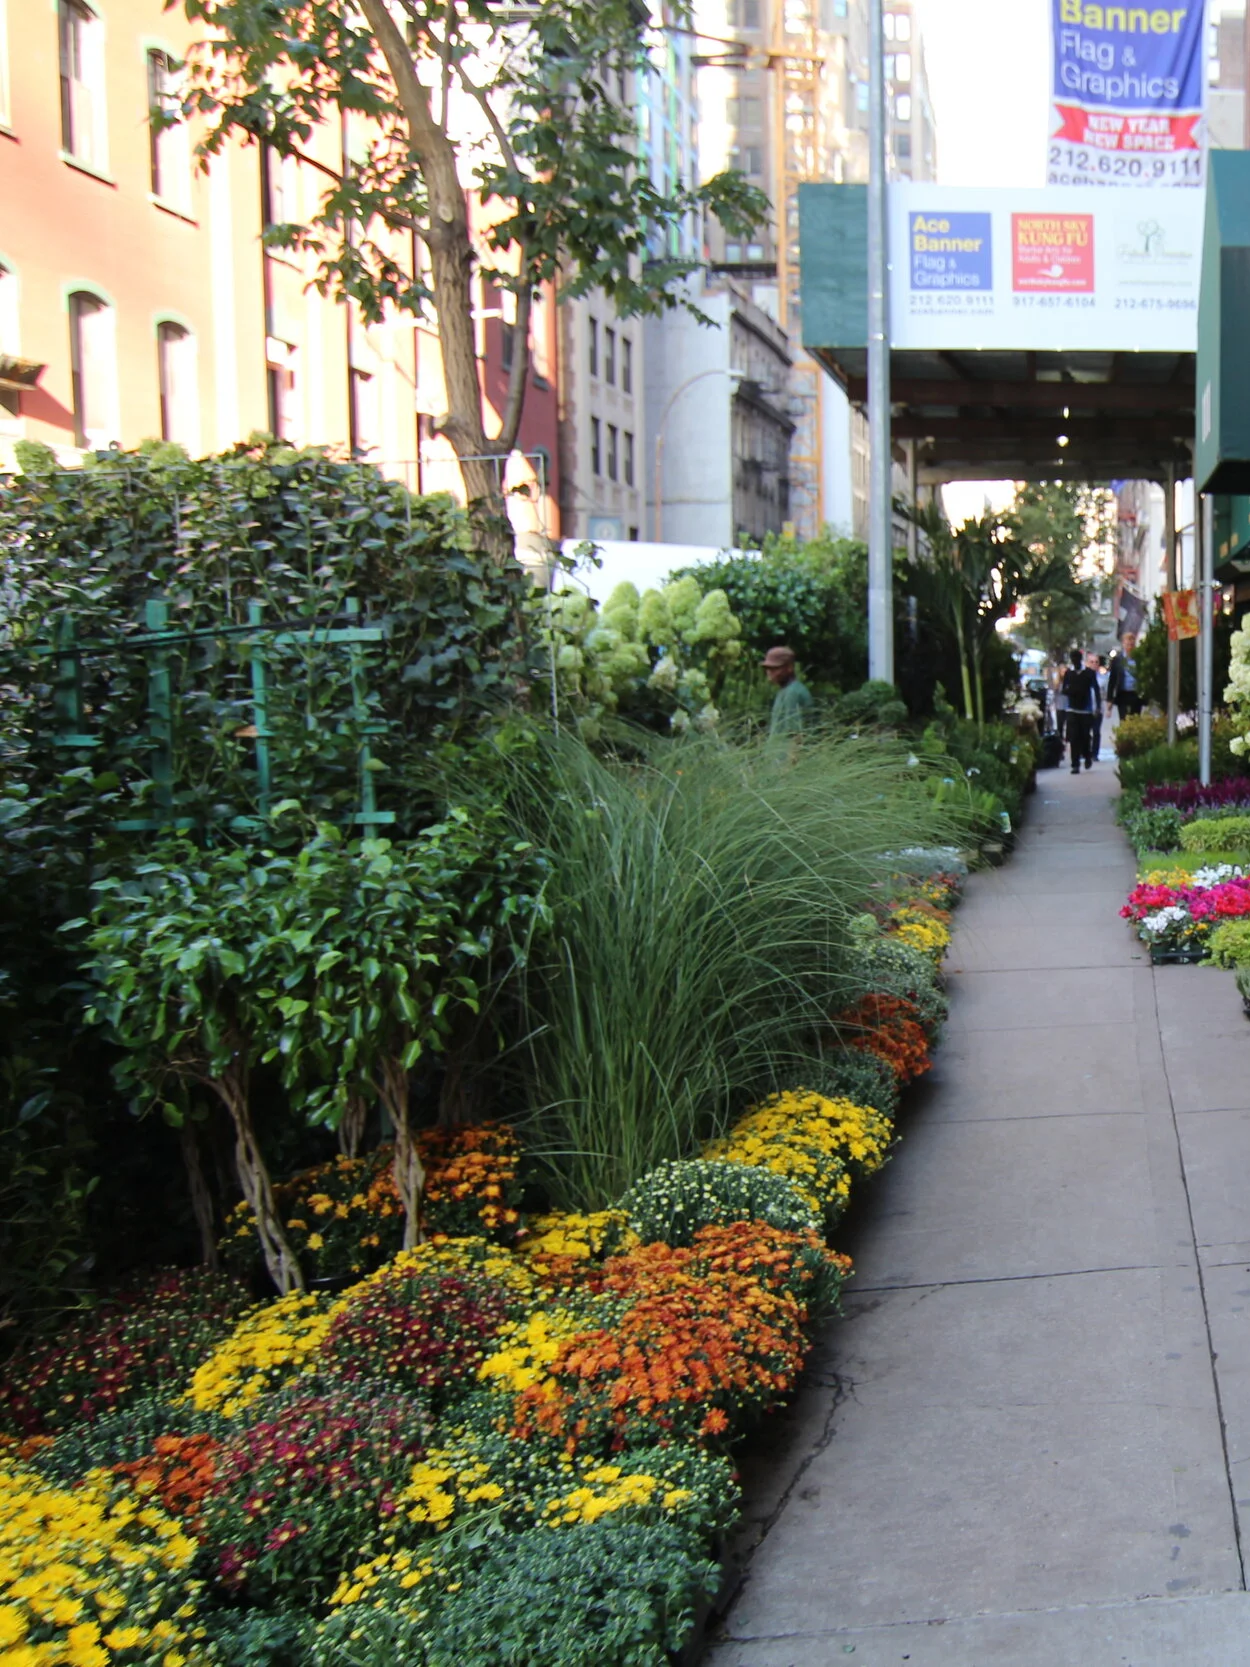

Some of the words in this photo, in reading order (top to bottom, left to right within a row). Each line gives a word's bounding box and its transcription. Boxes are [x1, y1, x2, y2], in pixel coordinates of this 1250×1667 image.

[1060, 0, 1186, 33] Banner
[1061, 29, 1114, 70] Flag
[1122, 46, 1136, 67] &
[1061, 63, 1180, 101] Graphics
[1088, 114, 1124, 132] NEW
[1128, 117, 1170, 134] YEAR
[1083, 129, 1119, 148] NEW
[1049, 146, 1201, 177] 212.620.9111
[913, 216, 949, 233] Ace
[914, 235, 982, 253] Banner
[1018, 231, 1064, 247] KUNG
[1066, 232, 1088, 247] FU
[914, 255, 945, 270] Flag
[914, 271, 980, 287] Graphics
